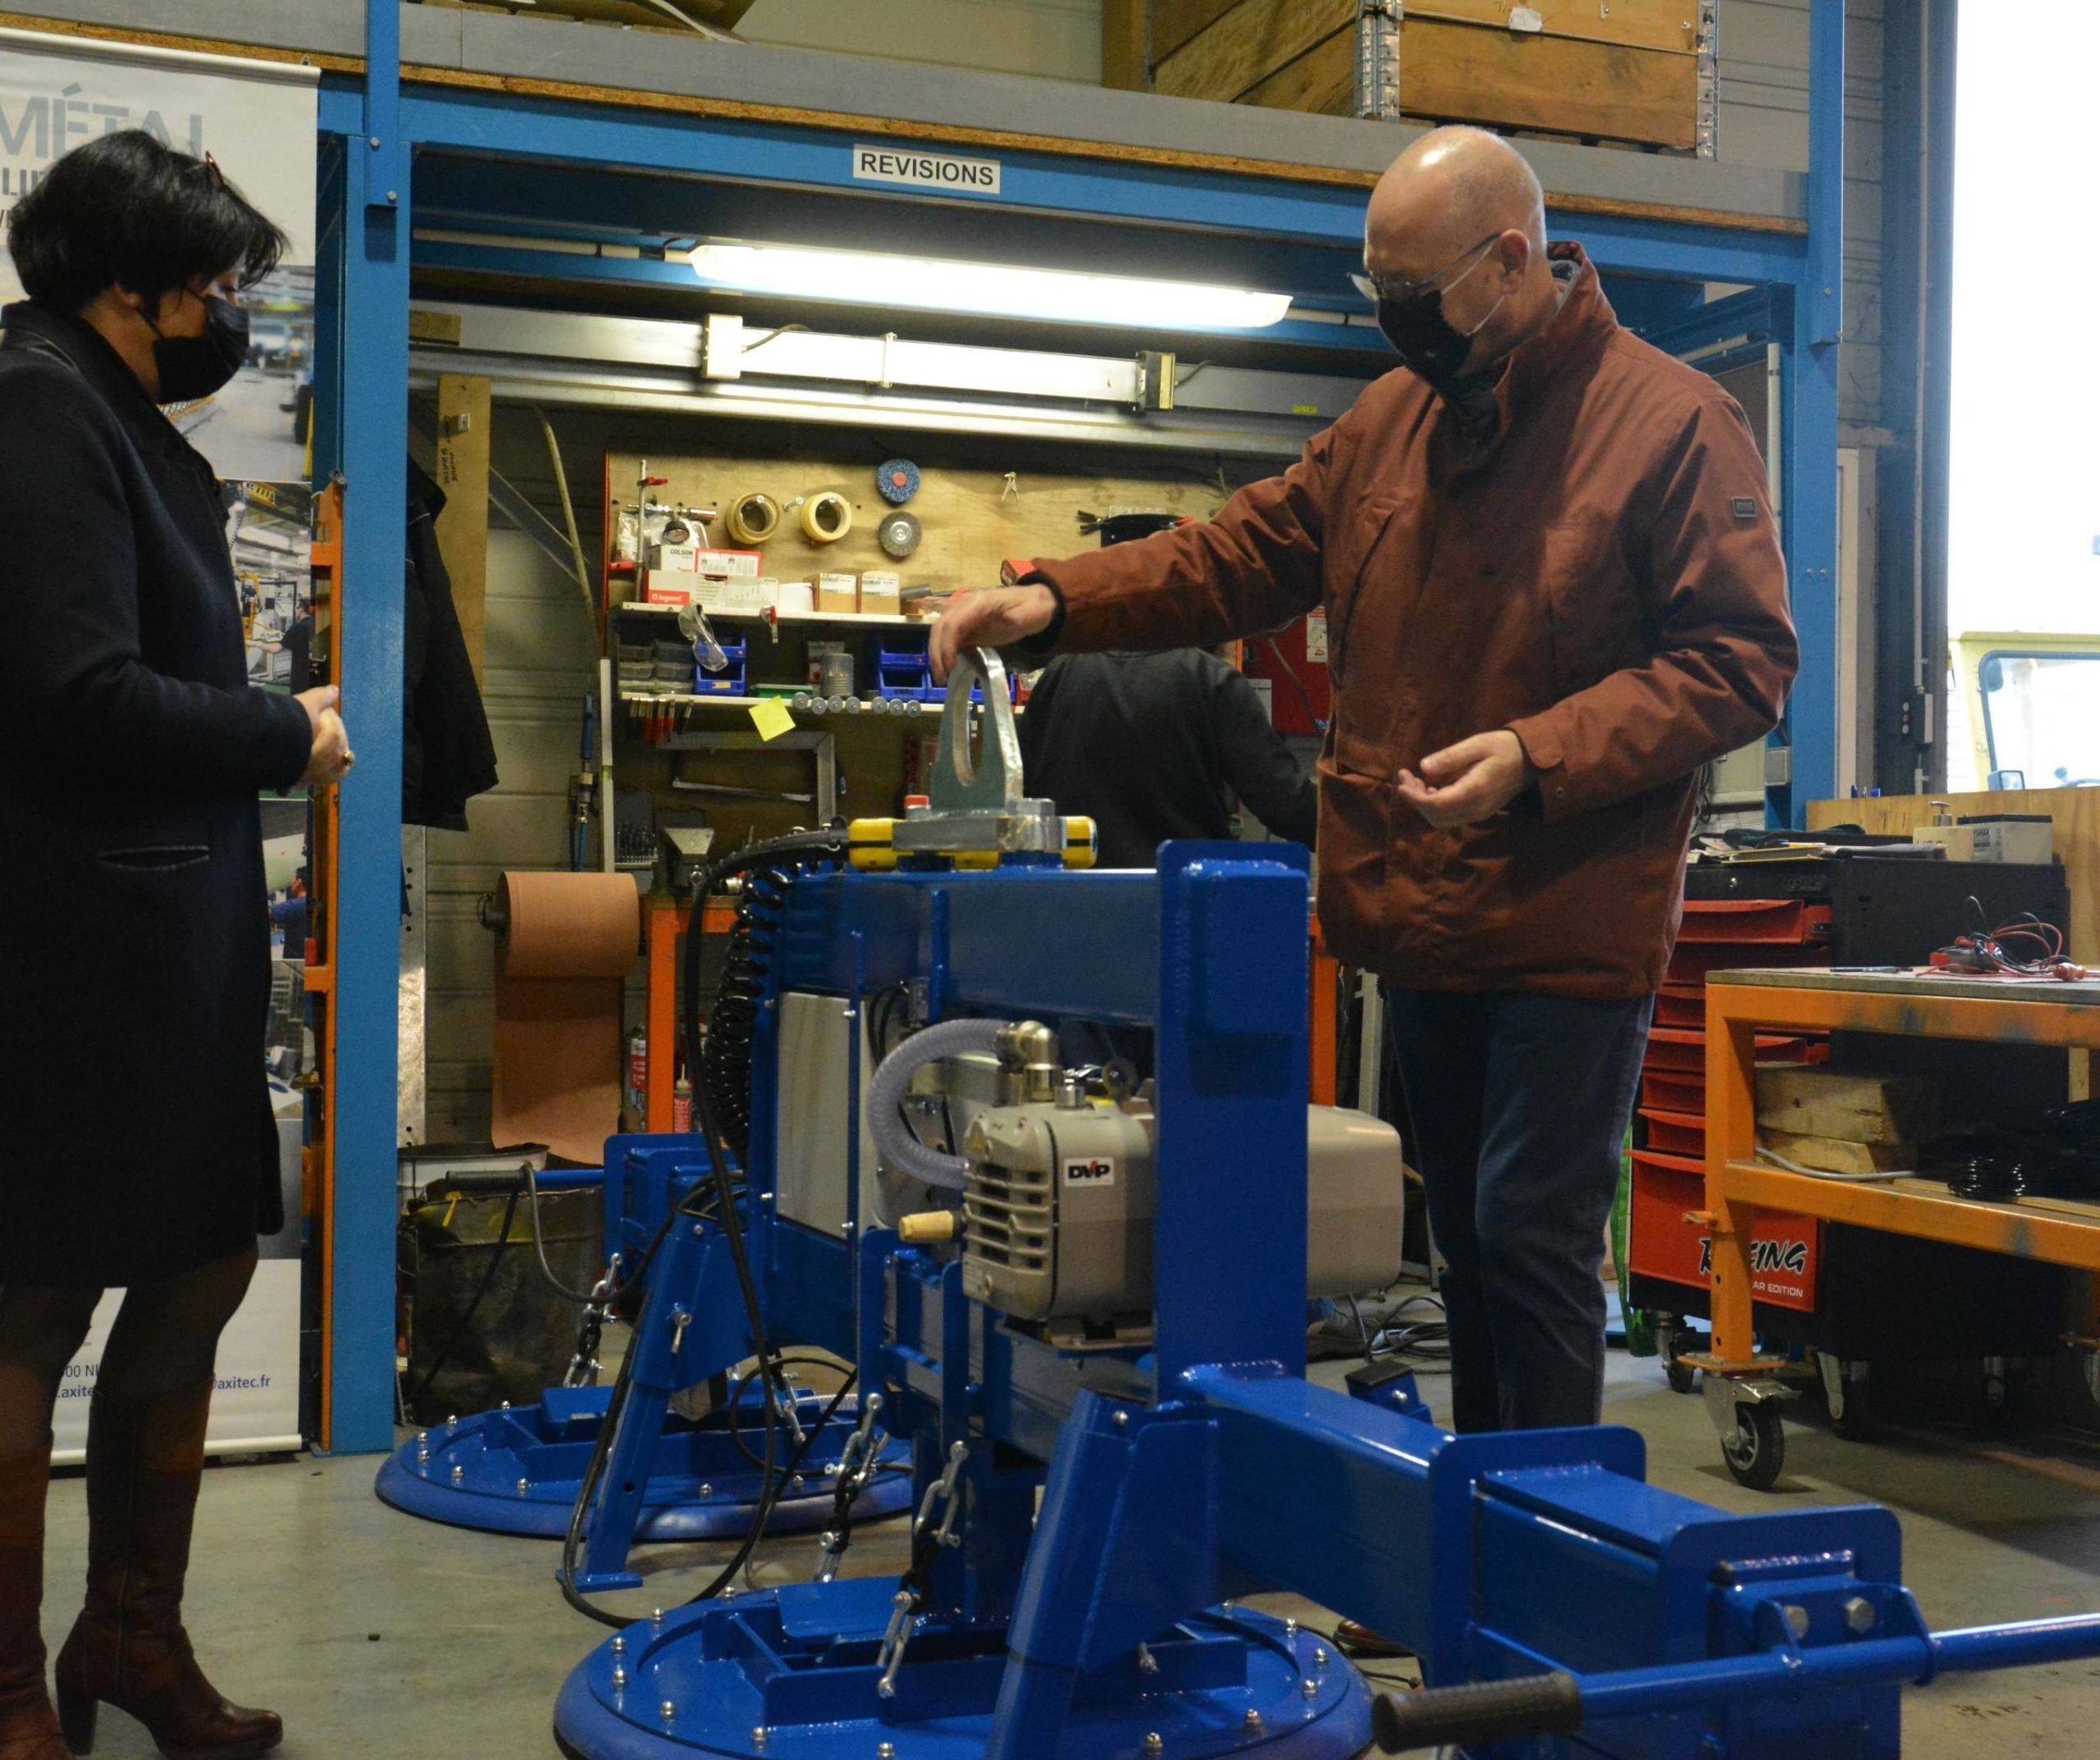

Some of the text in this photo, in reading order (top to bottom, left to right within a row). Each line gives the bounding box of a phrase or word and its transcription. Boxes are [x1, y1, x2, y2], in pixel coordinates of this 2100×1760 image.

[861, 153, 993, 186] REVISIONS
[658, 594, 682, 604] legrand
[1068, 1160, 1111, 1179] DVP
[1768, 1284, 1803, 1297] EDITION
